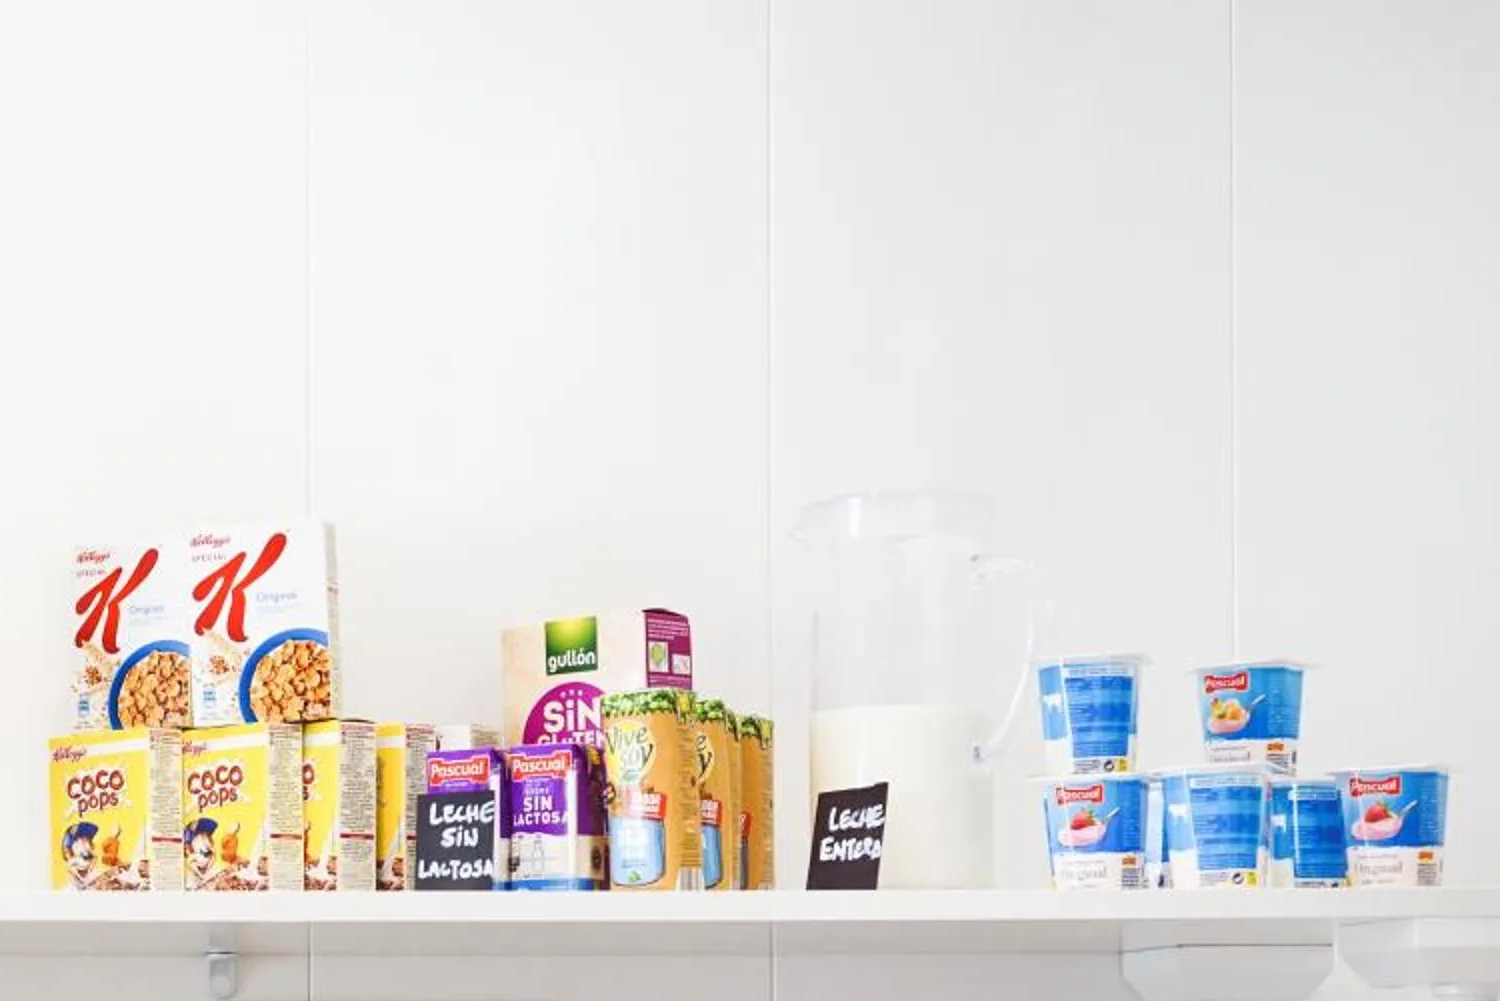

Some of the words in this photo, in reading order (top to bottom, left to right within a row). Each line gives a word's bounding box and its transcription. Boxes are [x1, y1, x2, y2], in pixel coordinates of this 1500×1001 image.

[548, 648, 596, 673] gullón
[431, 762, 485, 778] Pascual
[513, 757, 566, 774] Pascual
[429, 801, 495, 826] LECHE
[523, 795, 553, 813] SIN
[828, 803, 885, 832] LECHE
